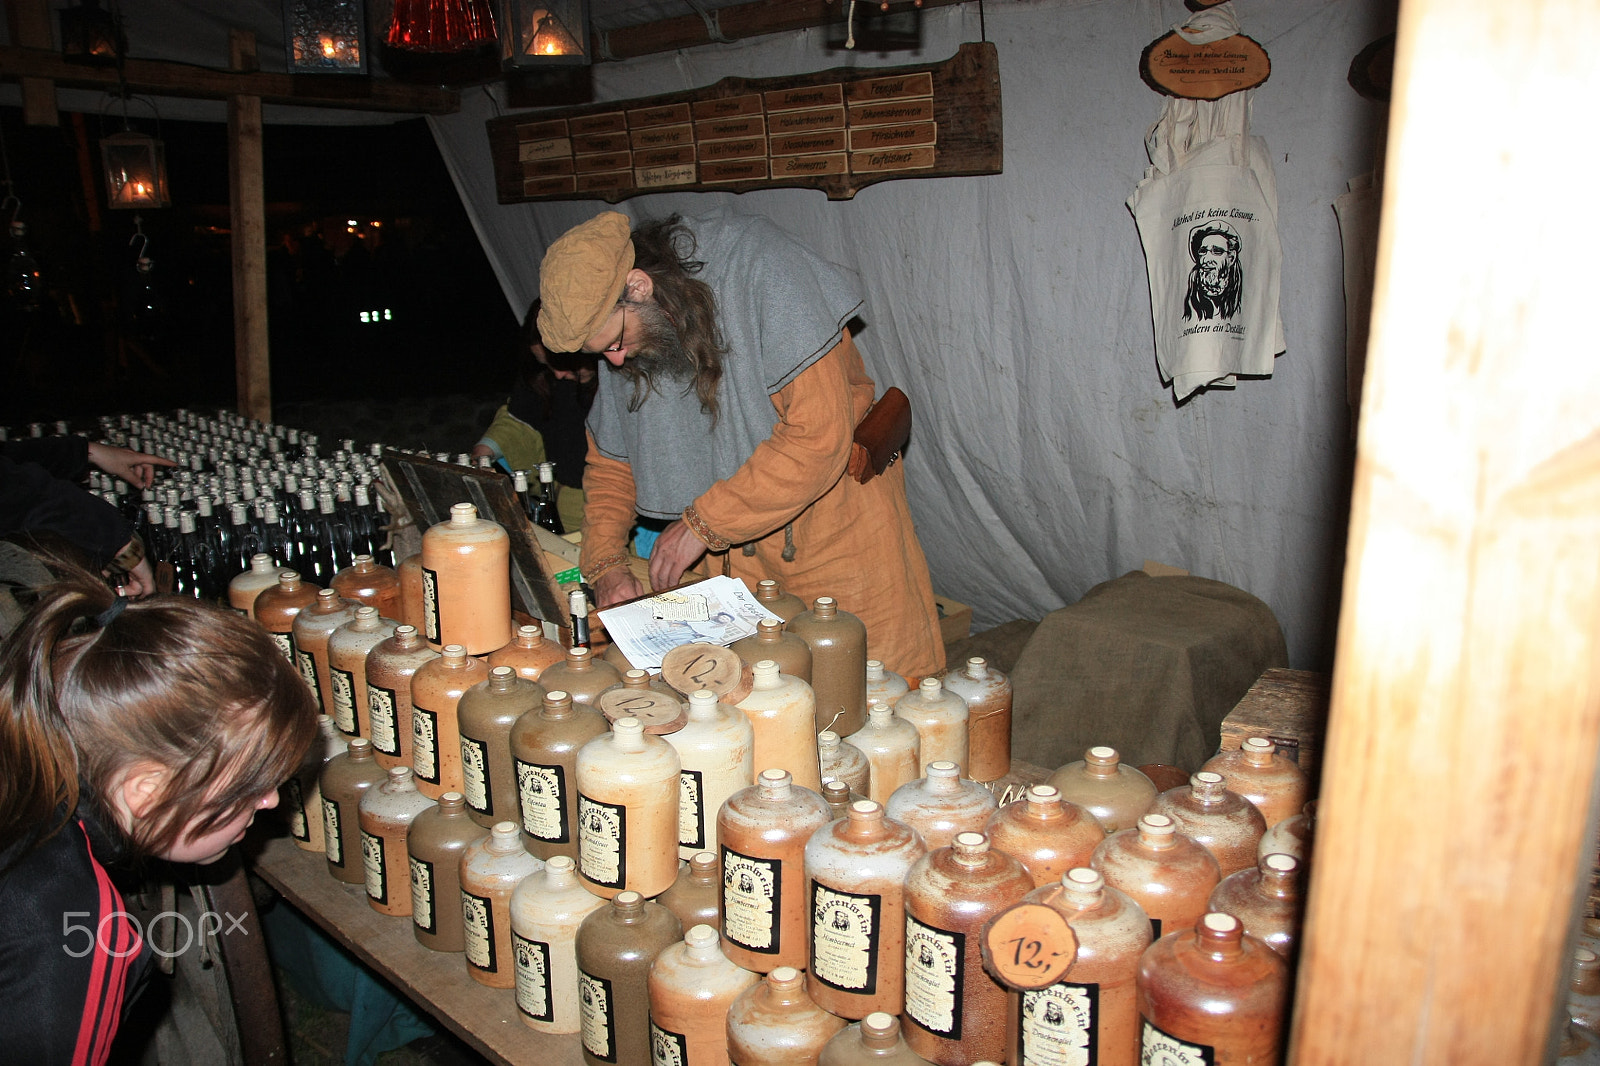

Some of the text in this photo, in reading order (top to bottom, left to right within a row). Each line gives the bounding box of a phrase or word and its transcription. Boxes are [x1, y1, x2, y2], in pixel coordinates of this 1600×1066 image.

[871, 81, 904, 96] Feengold
[1195, 209, 1206, 220] ist
[1208, 207, 1229, 218] keine
[1212, 323, 1224, 333] ein
[725, 863, 772, 896] Beerenwein
[815, 900, 869, 933] Beerenwein
